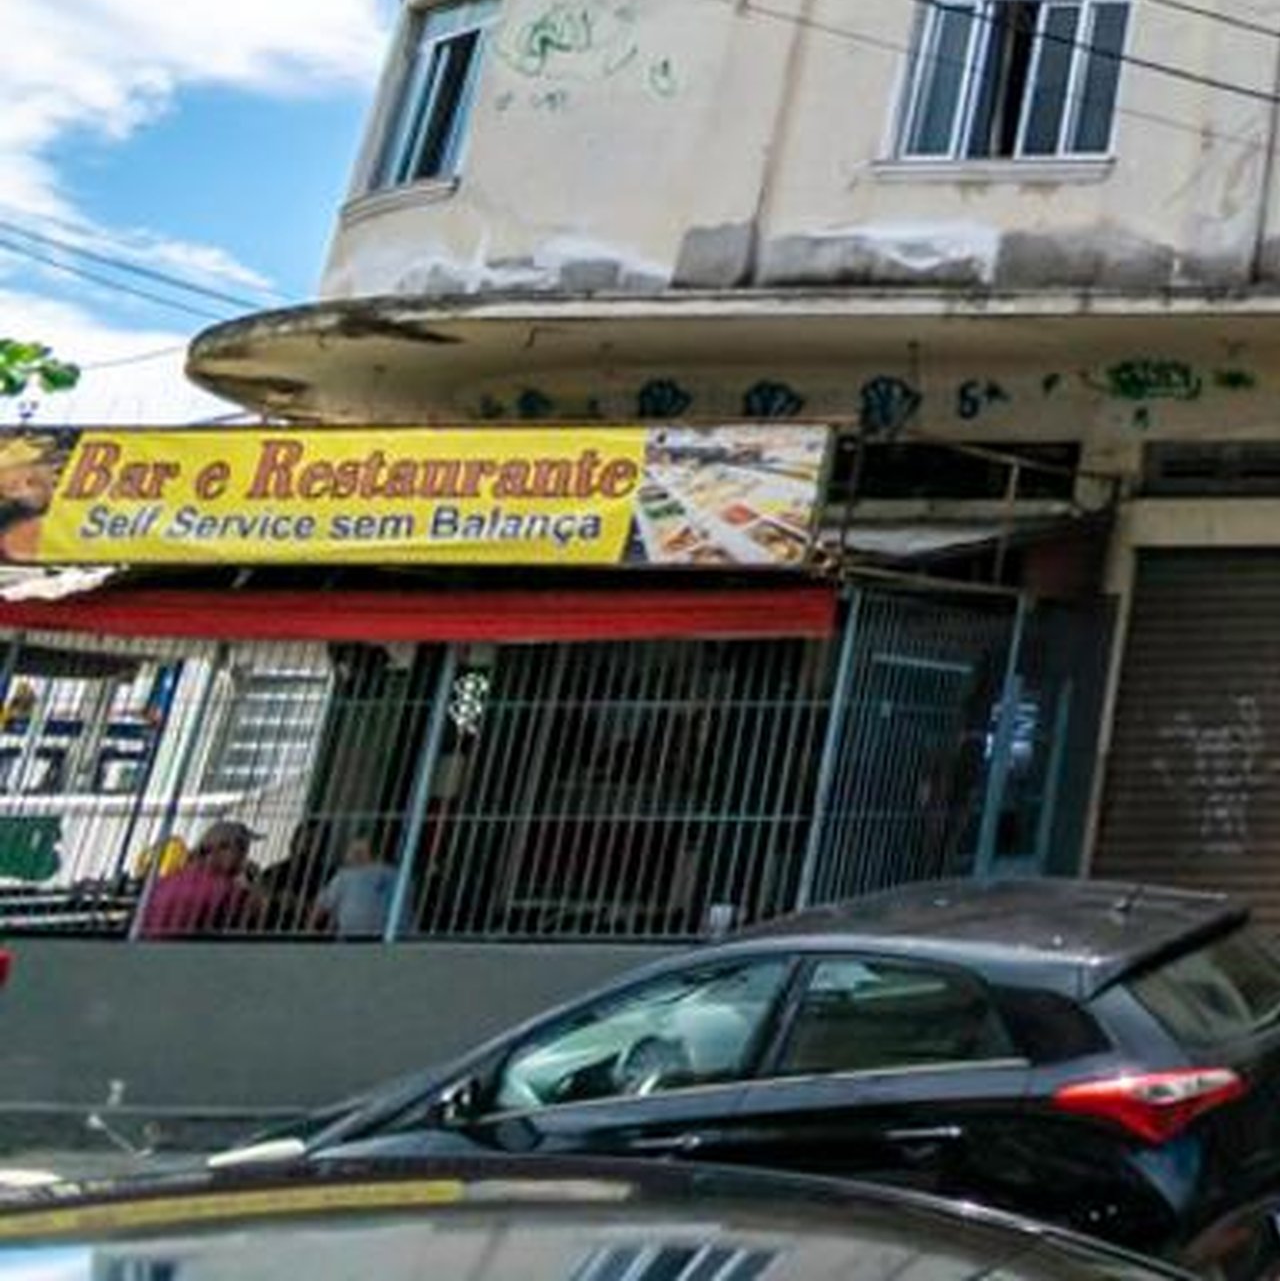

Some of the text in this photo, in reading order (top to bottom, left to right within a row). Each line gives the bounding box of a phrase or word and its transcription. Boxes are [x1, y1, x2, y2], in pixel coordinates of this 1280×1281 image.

[61, 438, 639, 500] Bar e Restaurante
[80, 505, 601, 545] Self Service sem Balança
